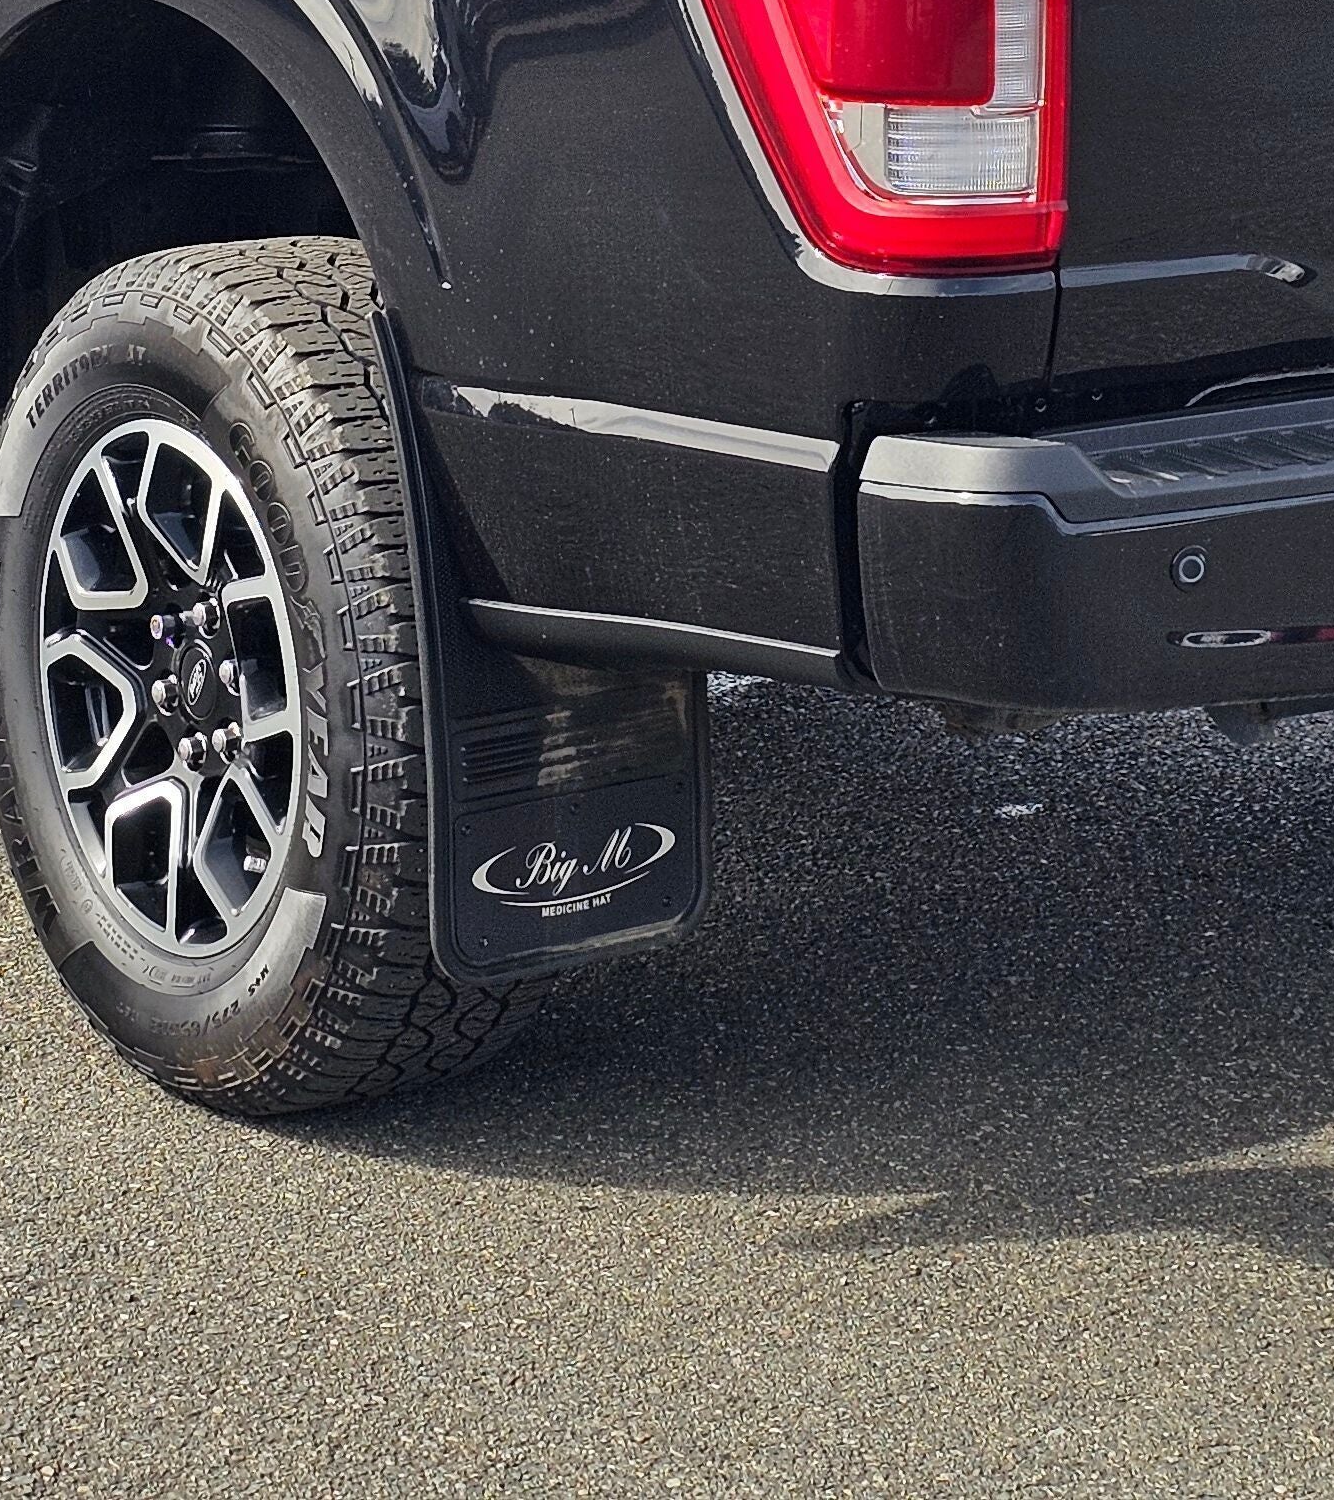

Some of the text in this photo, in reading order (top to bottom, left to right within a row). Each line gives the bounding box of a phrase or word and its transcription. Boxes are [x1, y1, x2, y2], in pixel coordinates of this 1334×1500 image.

[25, 343, 116, 430] TERRITORY
[229, 420, 332, 859] GOODYEAR
[515, 828, 633, 896] Big M
[541, 893, 611, 917] MEDICINE HAT
